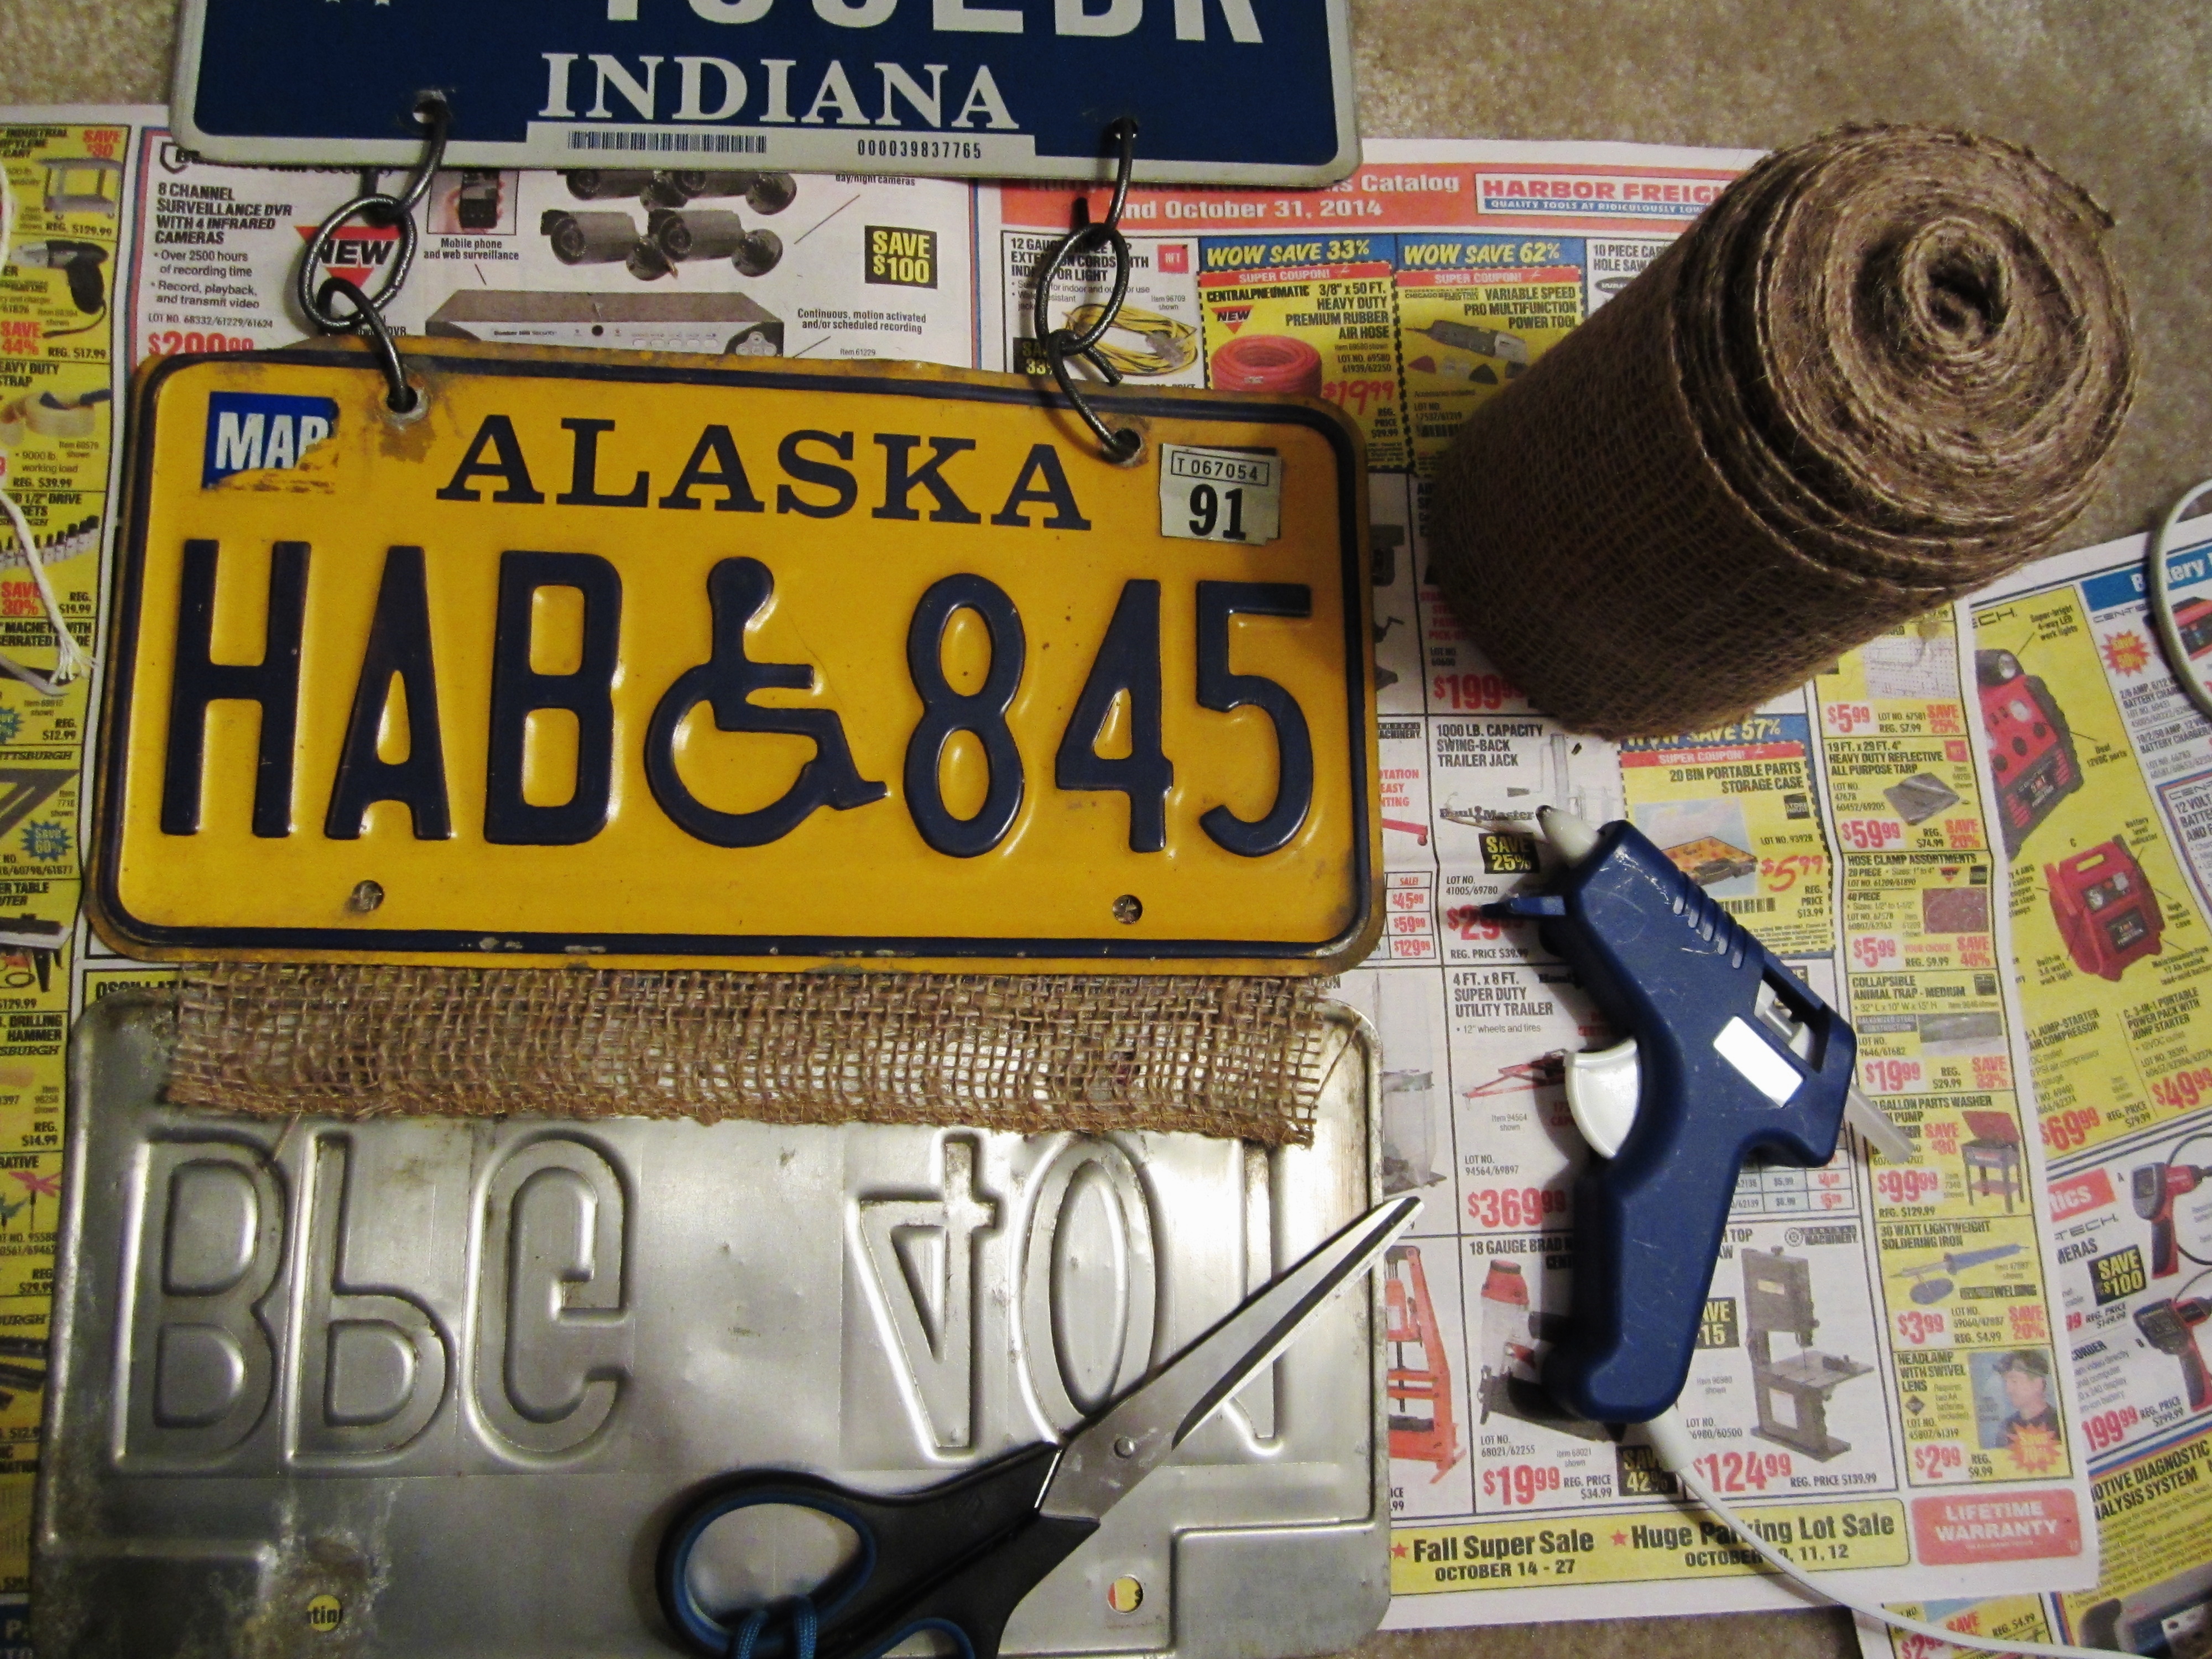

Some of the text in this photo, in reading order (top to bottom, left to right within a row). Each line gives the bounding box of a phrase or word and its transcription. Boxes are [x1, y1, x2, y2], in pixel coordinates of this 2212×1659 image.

[539, 53, 1019, 129] INDIANA
[858, 139, 981, 159] 000039837765
[878, 176, 915, 186] cameras
[1361, 175, 1459, 192] Catalog
[169, 185, 234, 200] CHANNEL
[1483, 180, 1724, 202] HARBOR FREIG
[157, 200, 292, 216] SURVEILLANCE DVR
[1165, 200, 1383, 218] October 31, 2014
[1492, 201, 1538, 209] QUALITY
[1543, 201, 1577, 210] TOOLS
[1599, 203, 1675, 213] RIDICULOUSLY
[156, 216, 275, 230] WITH INFRARED
[155, 231, 224, 244] CAMERAS
[441, 238, 502, 250] Mobile phone
[873, 231, 930, 259] SAVE
[1593, 245, 1639, 258] 10 PIECE
[161, 249, 248, 262] Over 2500 hours
[424, 249, 519, 260] and web surveillance
[1208, 239, 1370, 267] WOW SAVE 33%
[1404, 242, 1560, 265] WOW SAVE 62%
[160, 265, 252, 278] of recording time
[873, 255, 929, 283] $100
[1593, 258, 1620, 272] HOLE
[1076, 270, 1107, 281] LIGHT
[1280, 269, 1329, 280] COUPON!
[1474, 272, 1521, 283] COUPON!
[158, 281, 257, 296] Record, playback,
[1353, 281, 1385, 294] 50 FT.
[1485, 286, 1575, 300] VARIABLE SPEED
[156, 295, 259, 308] and transmit video
[1317, 296, 1387, 310] HEAVY DUTY
[1464, 301, 1577, 315] PRO MULTIFUNCTION
[798, 309, 926, 323] Continuous, motion activated
[1218, 310, 1251, 321] NEW
[1286, 311, 1389, 326] PREMIUM RUBBER
[1509, 316, 1548, 329] POWER
[802, 320, 922, 333] and/or scheduled recording
[1339, 326, 1389, 340] AIR HOSE
[59, 465, 78, 473] load
[436, 414, 1092, 531] ALASKA
[49, 494, 81, 505] DRIVE
[1189, 484, 1246, 540] 91
[160, 539, 1317, 858] HAB 845
[1438, 724, 1543, 737] 1000 LB. CAPACITY
[1741, 719, 1781, 740] 57%
[1438, 739, 1511, 752] SWING-BACK
[1439, 754, 1519, 766] TRAILER JACK
[1829, 752, 1943, 764] HEAVY DUTY REFLECTIVE
[1670, 763, 1801, 781] 20 BIN PORTABLE PARTS
[1832, 764, 1917, 775] ALL PURPOSE TARP
[1722, 778, 1803, 793] STORAGE CASE
[1486, 836, 1528, 853] SAVE
[1493, 854, 1531, 871] 25%
[14, 883, 49, 894] TABLE
[1447, 886, 1498, 895] 41005/69780
[1801, 896, 1823, 905] PRICE
[1473, 949, 1496, 958] PRICE
[1463, 972, 1519, 985] FT. FT.
[1455, 988, 1526, 1001] SUPER DUTY
[1854, 988, 1917, 999] ANIMAL TRAP
[1456, 1003, 1553, 1018] UTILITY TRAILER
[10, 1015, 62, 1028] DRILLING
[1478, 1024, 1506, 1033] wheels
[8, 1029, 62, 1042] HAMMER
[1880, 1095, 1992, 1110] GALLON PARTS WASHER
[1895, 1112, 1924, 1123] PUMP
[1733, 1229, 1753, 1242] TOP
[1895, 1222, 1990, 1235] WATT LIGHTWEIGHT
[1470, 1240, 1526, 1255] 18 GAUGE
[2098, 1250, 2140, 1279] SAVE
[2104, 1270, 2143, 1295] $100
[1898, 1352, 1954, 1364] HEADLAMP
[1900, 1364, 1965, 1378] WITH SWIVEL
[2133, 1439, 2210, 1483] DIAGNOSTIC
[1587, 1475, 1611, 1486] PRICE
[1814, 1473, 1877, 1485] PRICE $139.99
[2145, 1467, 2198, 1500] SYSTEM
[1582, 1488, 1612, 1499] $34.99
[1945, 1500, 2044, 1521] LIFETIME
[1798, 1513, 1894, 1540] Lot Sale
[1935, 1519, 2058, 1542] WARRANTY
[1632, 1524, 1693, 1551] Huge
[1414, 1530, 1594, 1562] Fall Super Sale
[1799, 1544, 1848, 1561] 11, 12
[1435, 1559, 1575, 1582] OCTOBER 14 27
